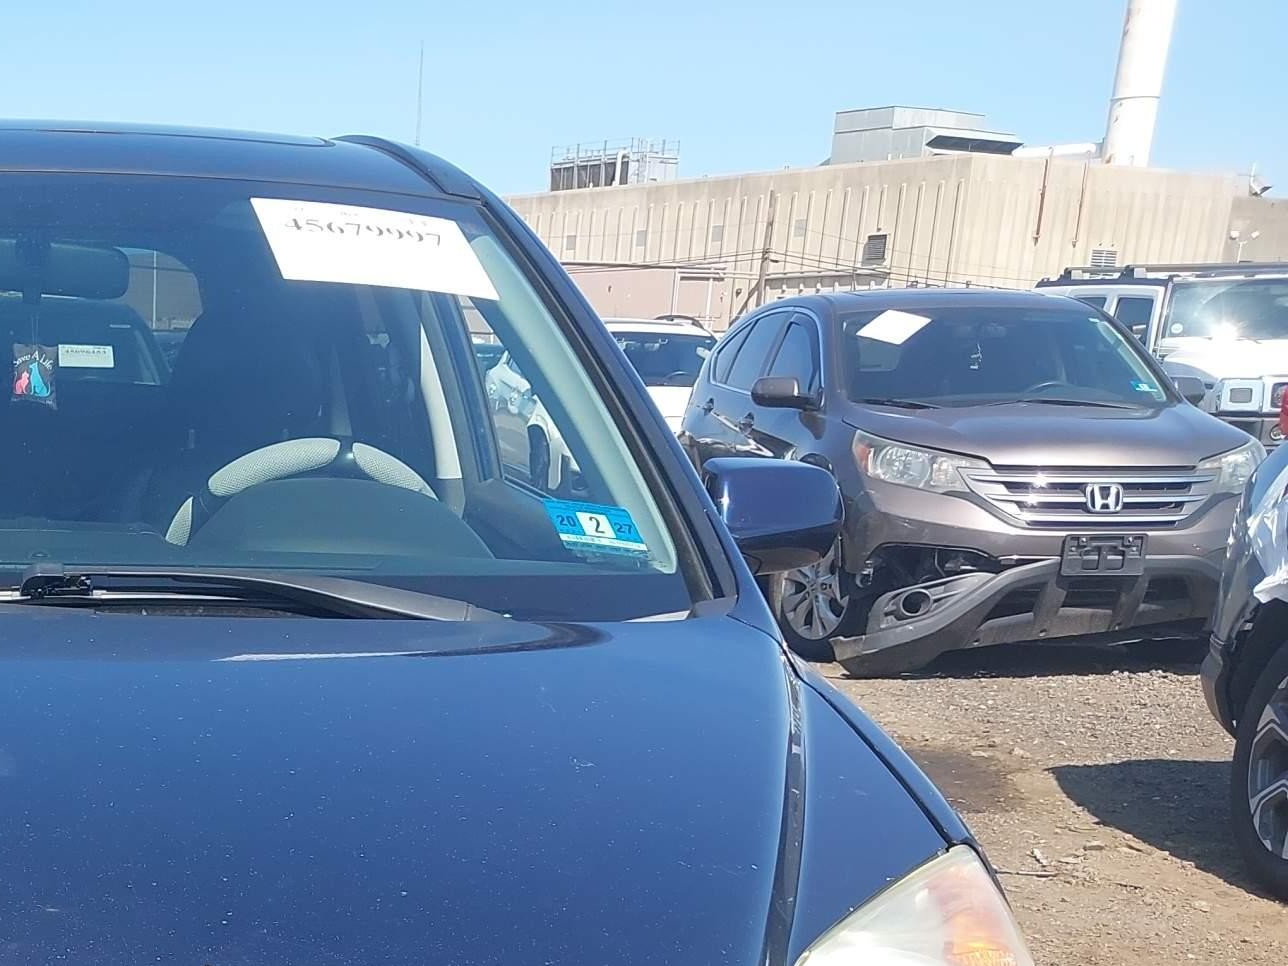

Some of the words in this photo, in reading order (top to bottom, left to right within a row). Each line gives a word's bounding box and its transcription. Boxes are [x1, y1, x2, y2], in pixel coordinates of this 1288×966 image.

[556, 514, 576, 527] 20
[588, 516, 605, 534] 2
[614, 522, 632, 535] 27
